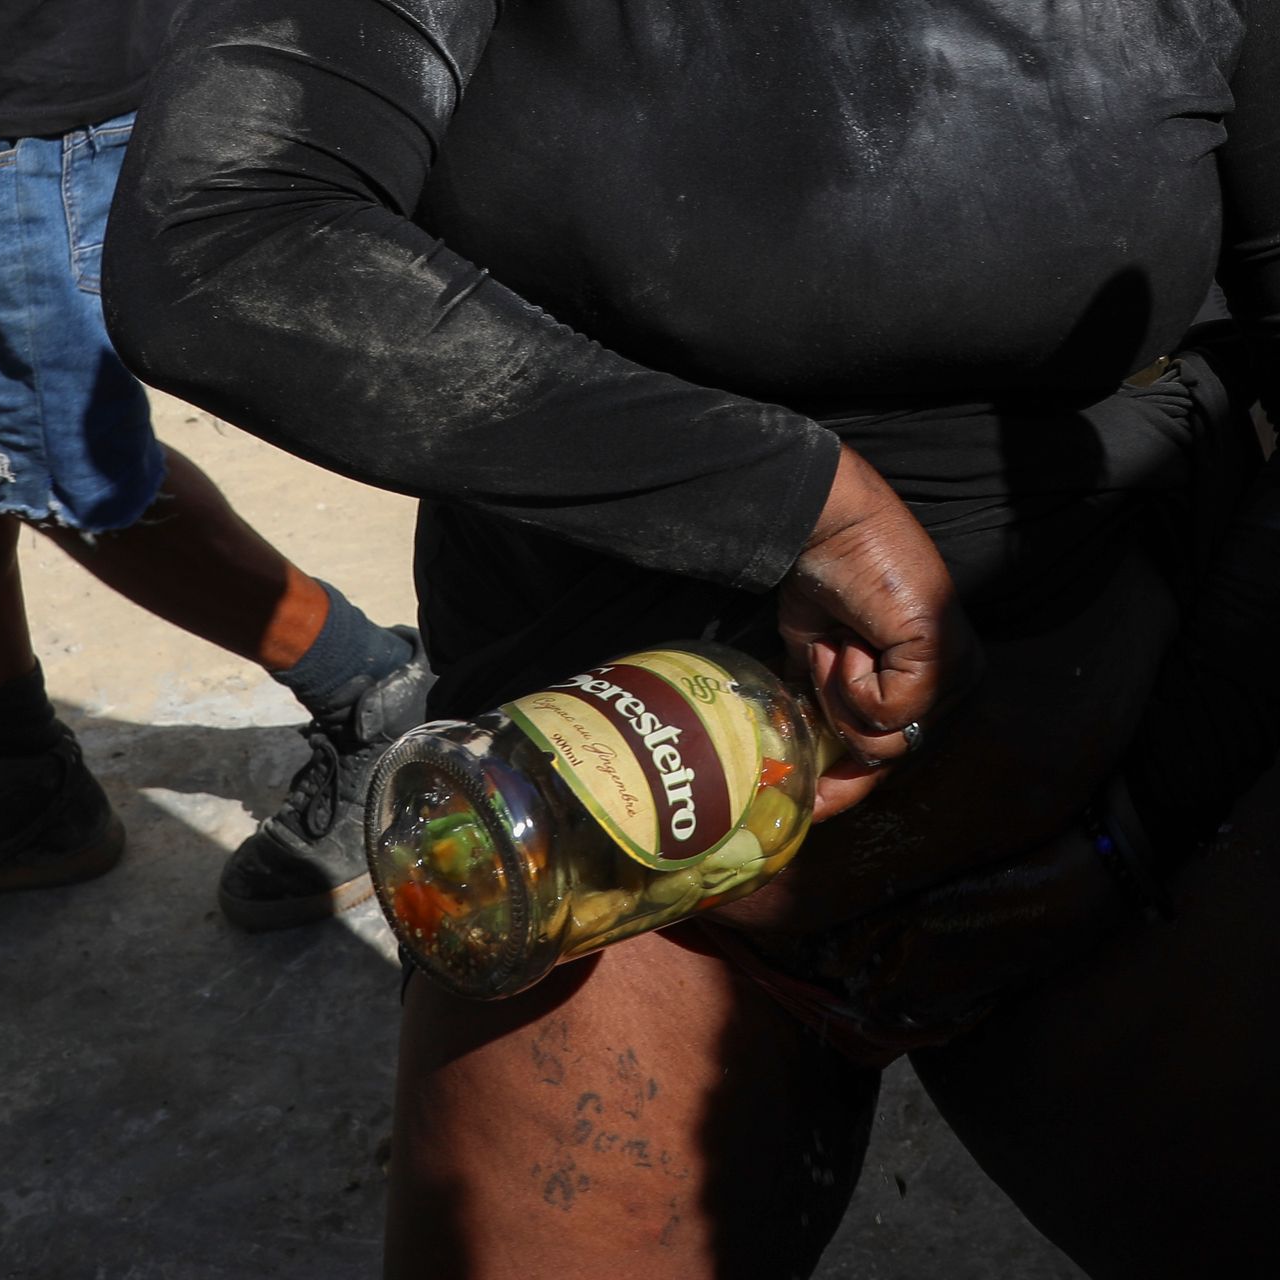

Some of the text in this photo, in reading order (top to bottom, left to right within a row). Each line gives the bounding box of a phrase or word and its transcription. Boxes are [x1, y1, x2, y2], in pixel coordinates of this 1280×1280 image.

[551, 732, 584, 768] 900ml
[574, 723, 593, 741] au
[581, 741, 641, 819] Gingembre
